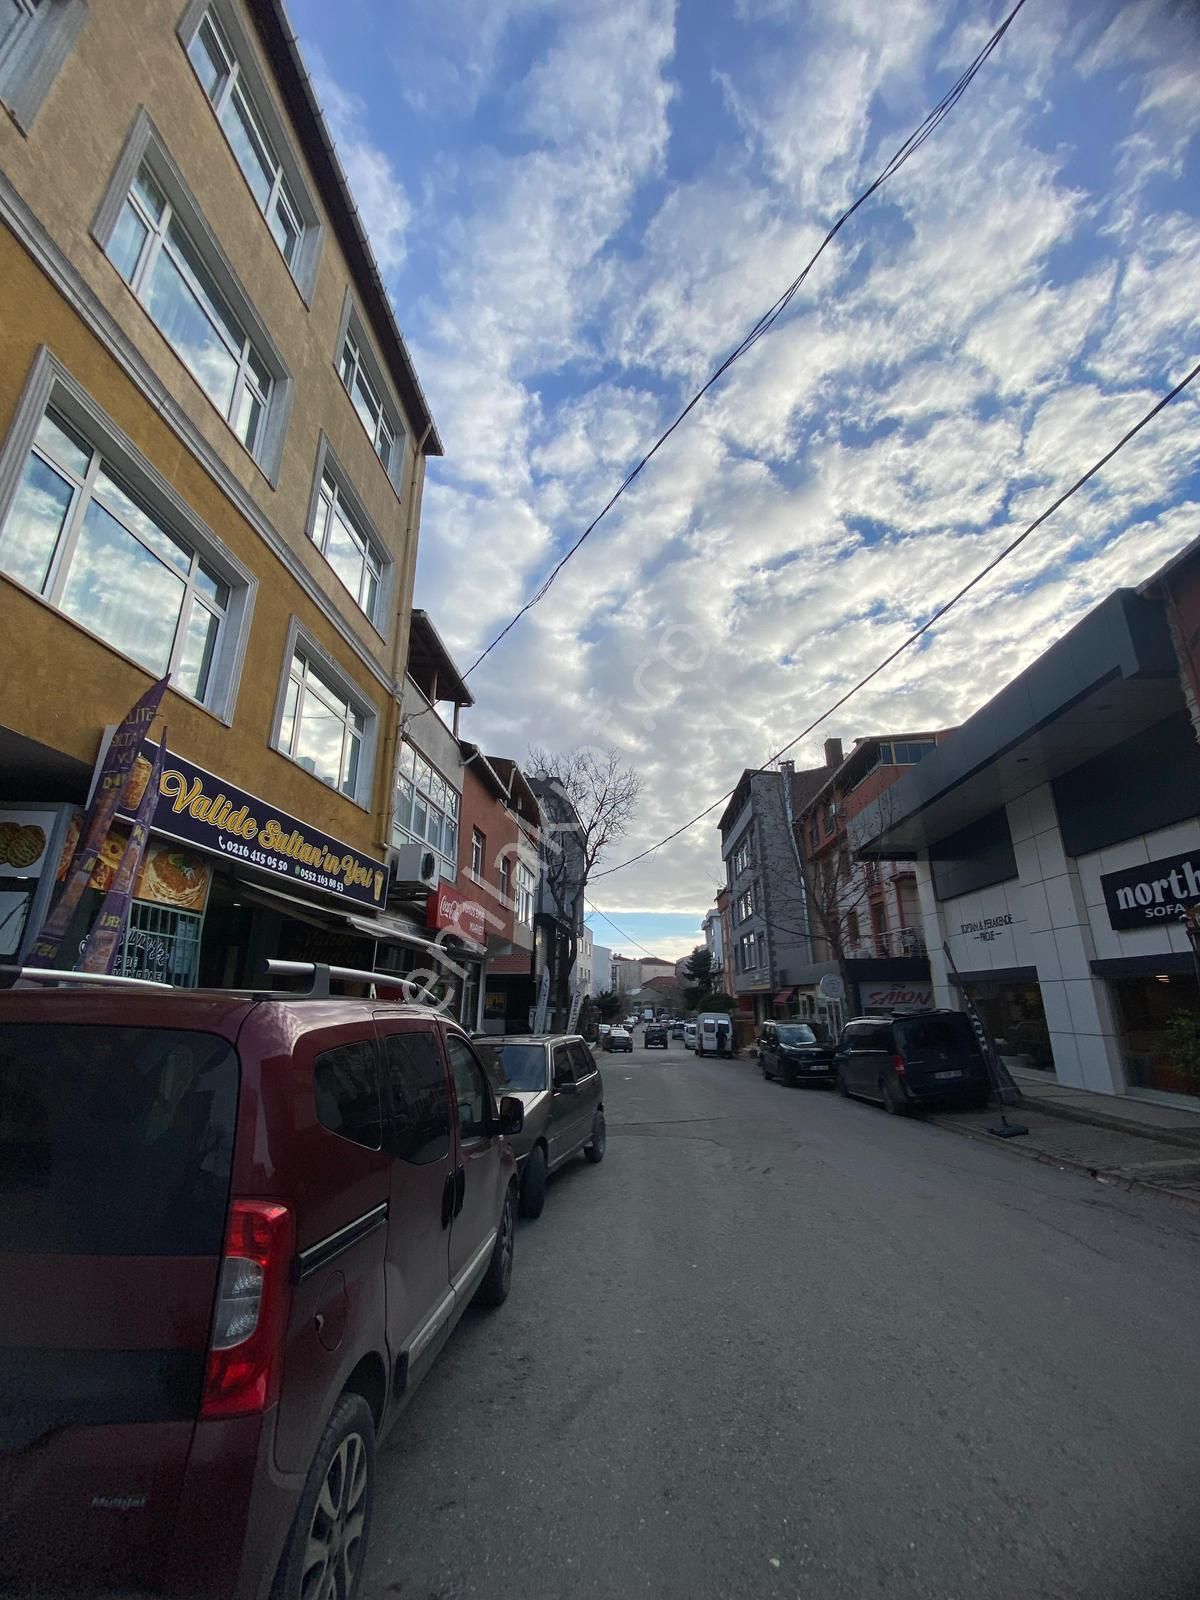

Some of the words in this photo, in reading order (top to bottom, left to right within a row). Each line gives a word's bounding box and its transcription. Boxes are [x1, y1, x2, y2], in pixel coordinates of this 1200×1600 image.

[159, 769, 258, 840] Valide
[227, 841, 249, 857] 0216
[250, 850, 266, 864] 415
[267, 856, 277, 868] 05
[278, 860, 288, 871] 50
[300, 868, 316, 881] 0552
[317, 874, 328, 886] 163
[336, 882, 344, 892] 53
[1115, 861, 1200, 909] north
[1144, 904, 1186, 917] SOFA
